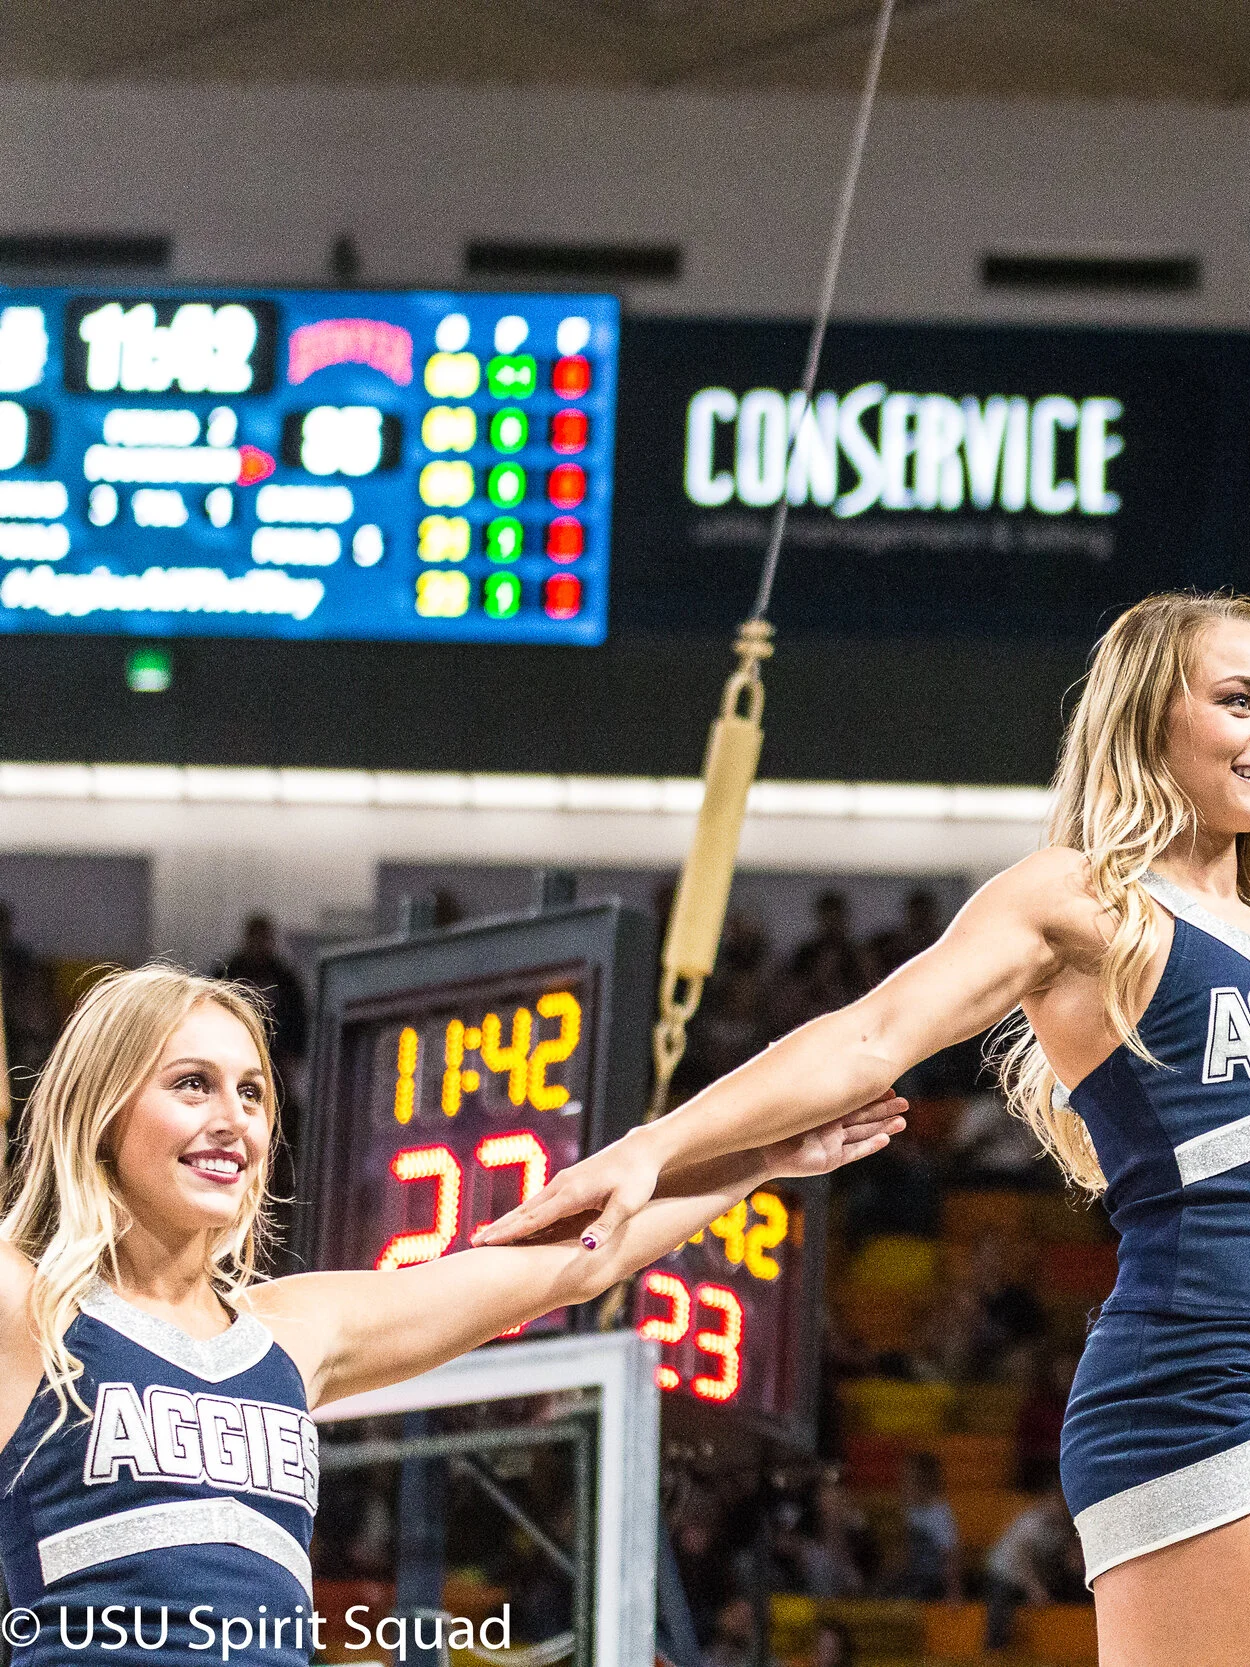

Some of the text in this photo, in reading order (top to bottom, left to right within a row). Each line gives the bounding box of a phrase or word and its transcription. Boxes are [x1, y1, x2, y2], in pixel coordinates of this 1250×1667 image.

[684, 381, 1125, 519] CONSERVICE
[394, 990, 583, 1125] 11:42
[83, 1382, 320, 1517] AGGIES
